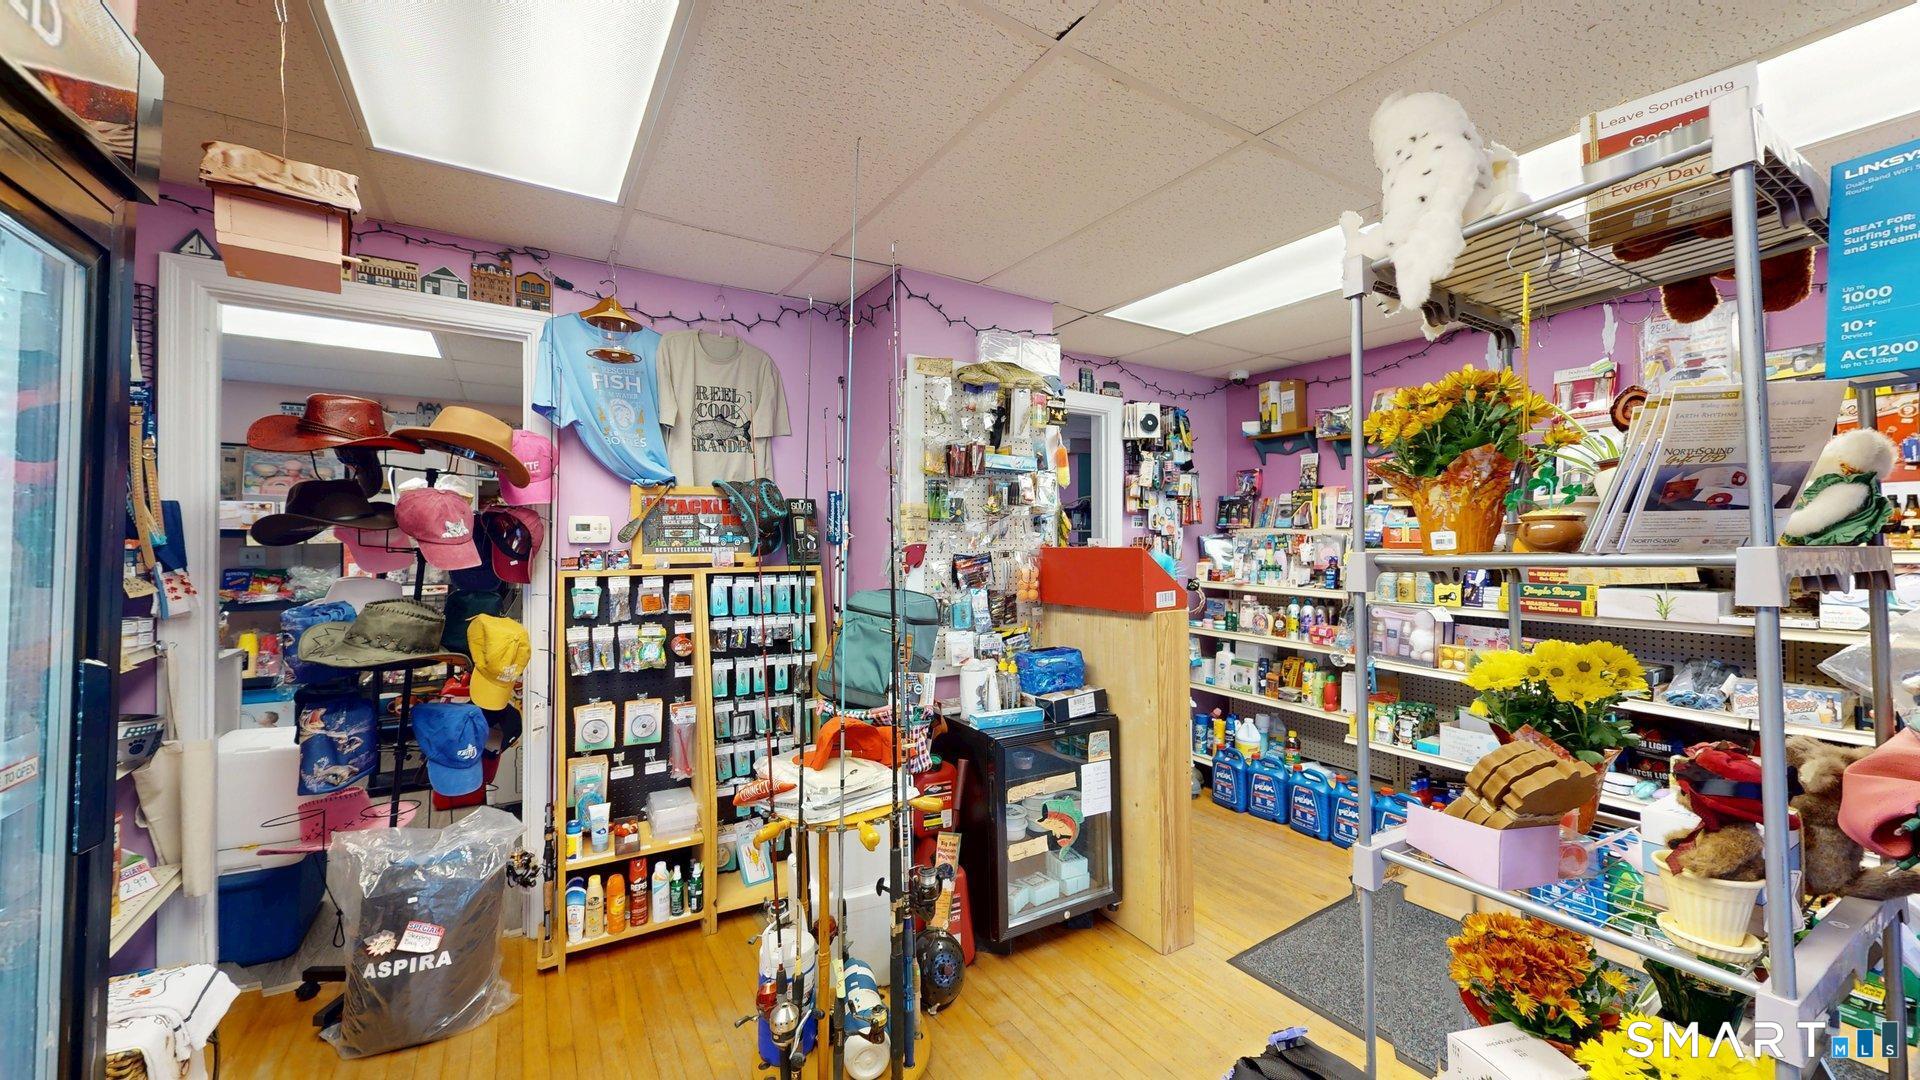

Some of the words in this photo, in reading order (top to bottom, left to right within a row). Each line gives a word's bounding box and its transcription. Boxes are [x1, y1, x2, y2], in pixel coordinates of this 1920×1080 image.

[1601, 110, 1644, 129] Leave
[1649, 81, 1734, 114] Something
[1611, 177, 1660, 197] Every
[1668, 165, 1705, 181] Day
[1845, 185, 1873, 196] Router
[1843, 221, 1884, 236] GREAT
[1886, 213, 1916, 226] FOR:
[1843, 229, 1891, 246] Surfing
[1893, 222, 1917, 234] the
[1843, 243, 1868, 256] and
[1841, 285, 1893, 304] 1000
[1841, 302, 1871, 312] Square
[1872, 298, 1892, 307] Feet
[1841, 320, 1877, 333] 10+
[1841, 331, 1873, 341] Devices
[1841, 340, 1919, 362] AC1200
[1853, 360, 1863, 368] to
[1875, 355, 1900, 365] Gbps
[592, 372, 641, 394] FISH
[695, 385, 741, 403] REEL
[696, 402, 741, 419] COOL
[692, 438, 754, 454] GRANDPA
[666, 499, 732, 515] TACKLE
[1648, 741, 1672, 752] LIGHT
[1215, 771, 1232, 781] PEAK
[1254, 783, 1275, 793] PEAK
[1294, 796, 1315, 807] PEAK
[363, 950, 453, 980] ASPIRA
